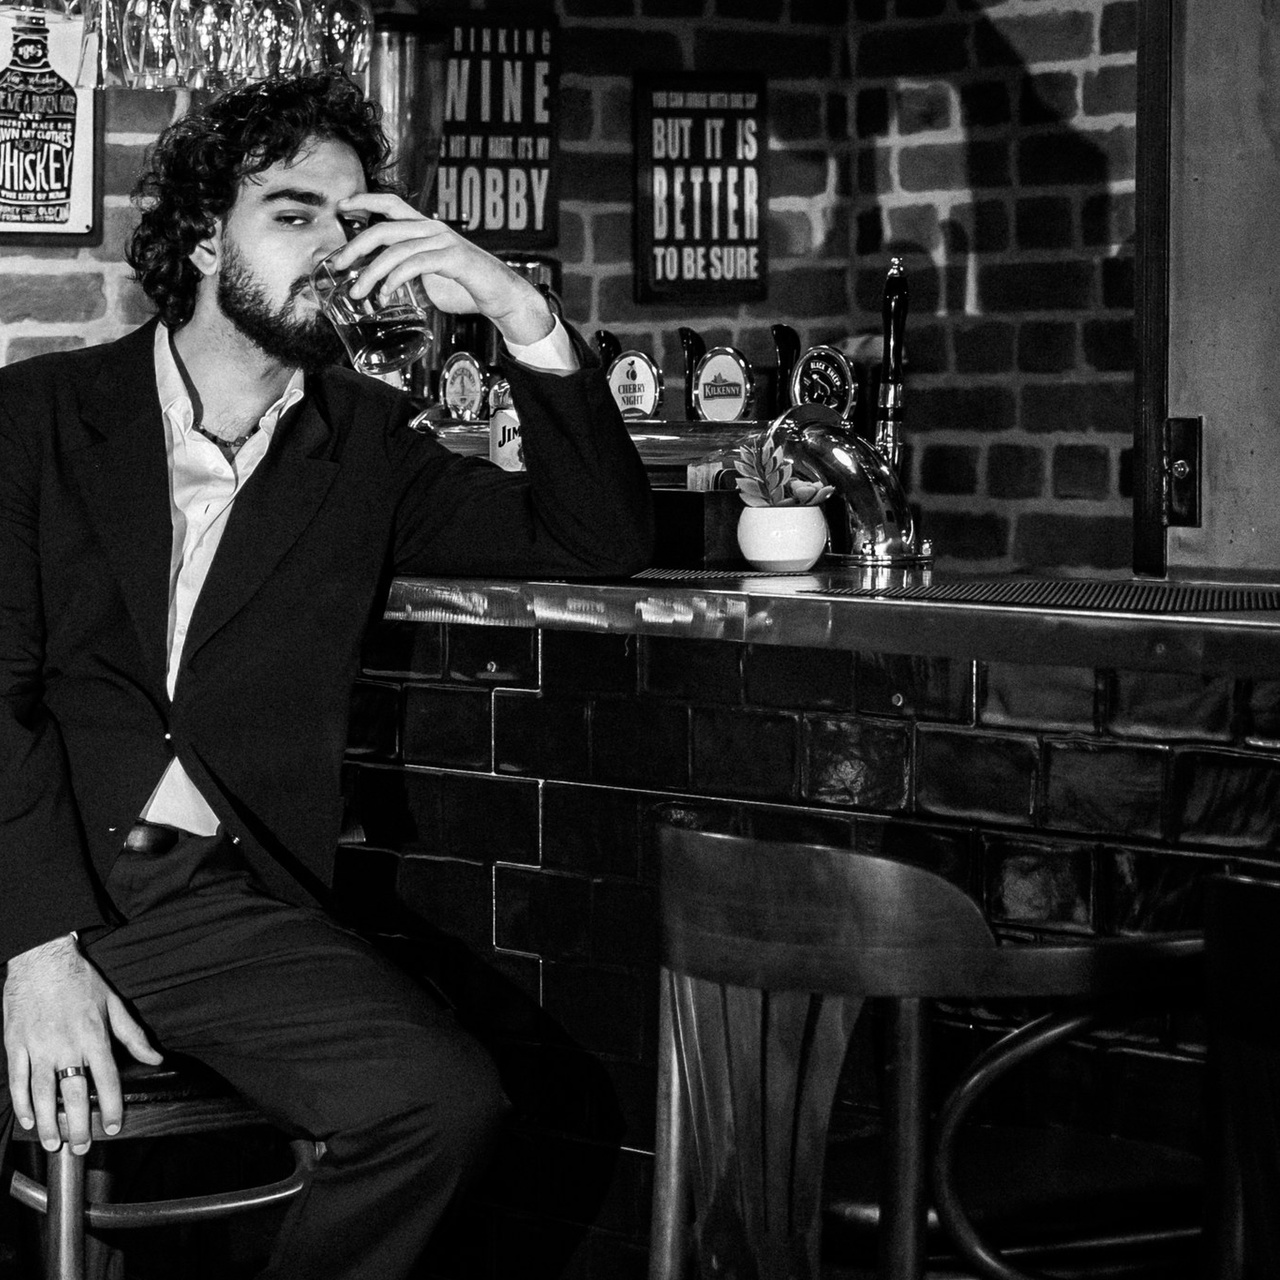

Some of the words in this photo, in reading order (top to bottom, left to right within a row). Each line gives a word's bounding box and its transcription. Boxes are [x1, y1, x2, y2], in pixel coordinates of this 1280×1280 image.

[453, 25, 552, 55] RINKING
[21, 129, 36, 139] MY
[36, 130, 72, 148] CLOTHES
[652, 117, 693, 160] BUT
[704, 117, 725, 160] IT
[736, 117, 758, 161] IS
[437, 166, 550, 231] HOBBY
[652, 165, 759, 240] BETTER
[653, 245, 679, 280] TO
[682, 245, 707, 280] BE
[709, 245, 759, 280] SURE
[618, 383, 645, 395] CHERRY
[621, 395, 644, 406] NIGHT
